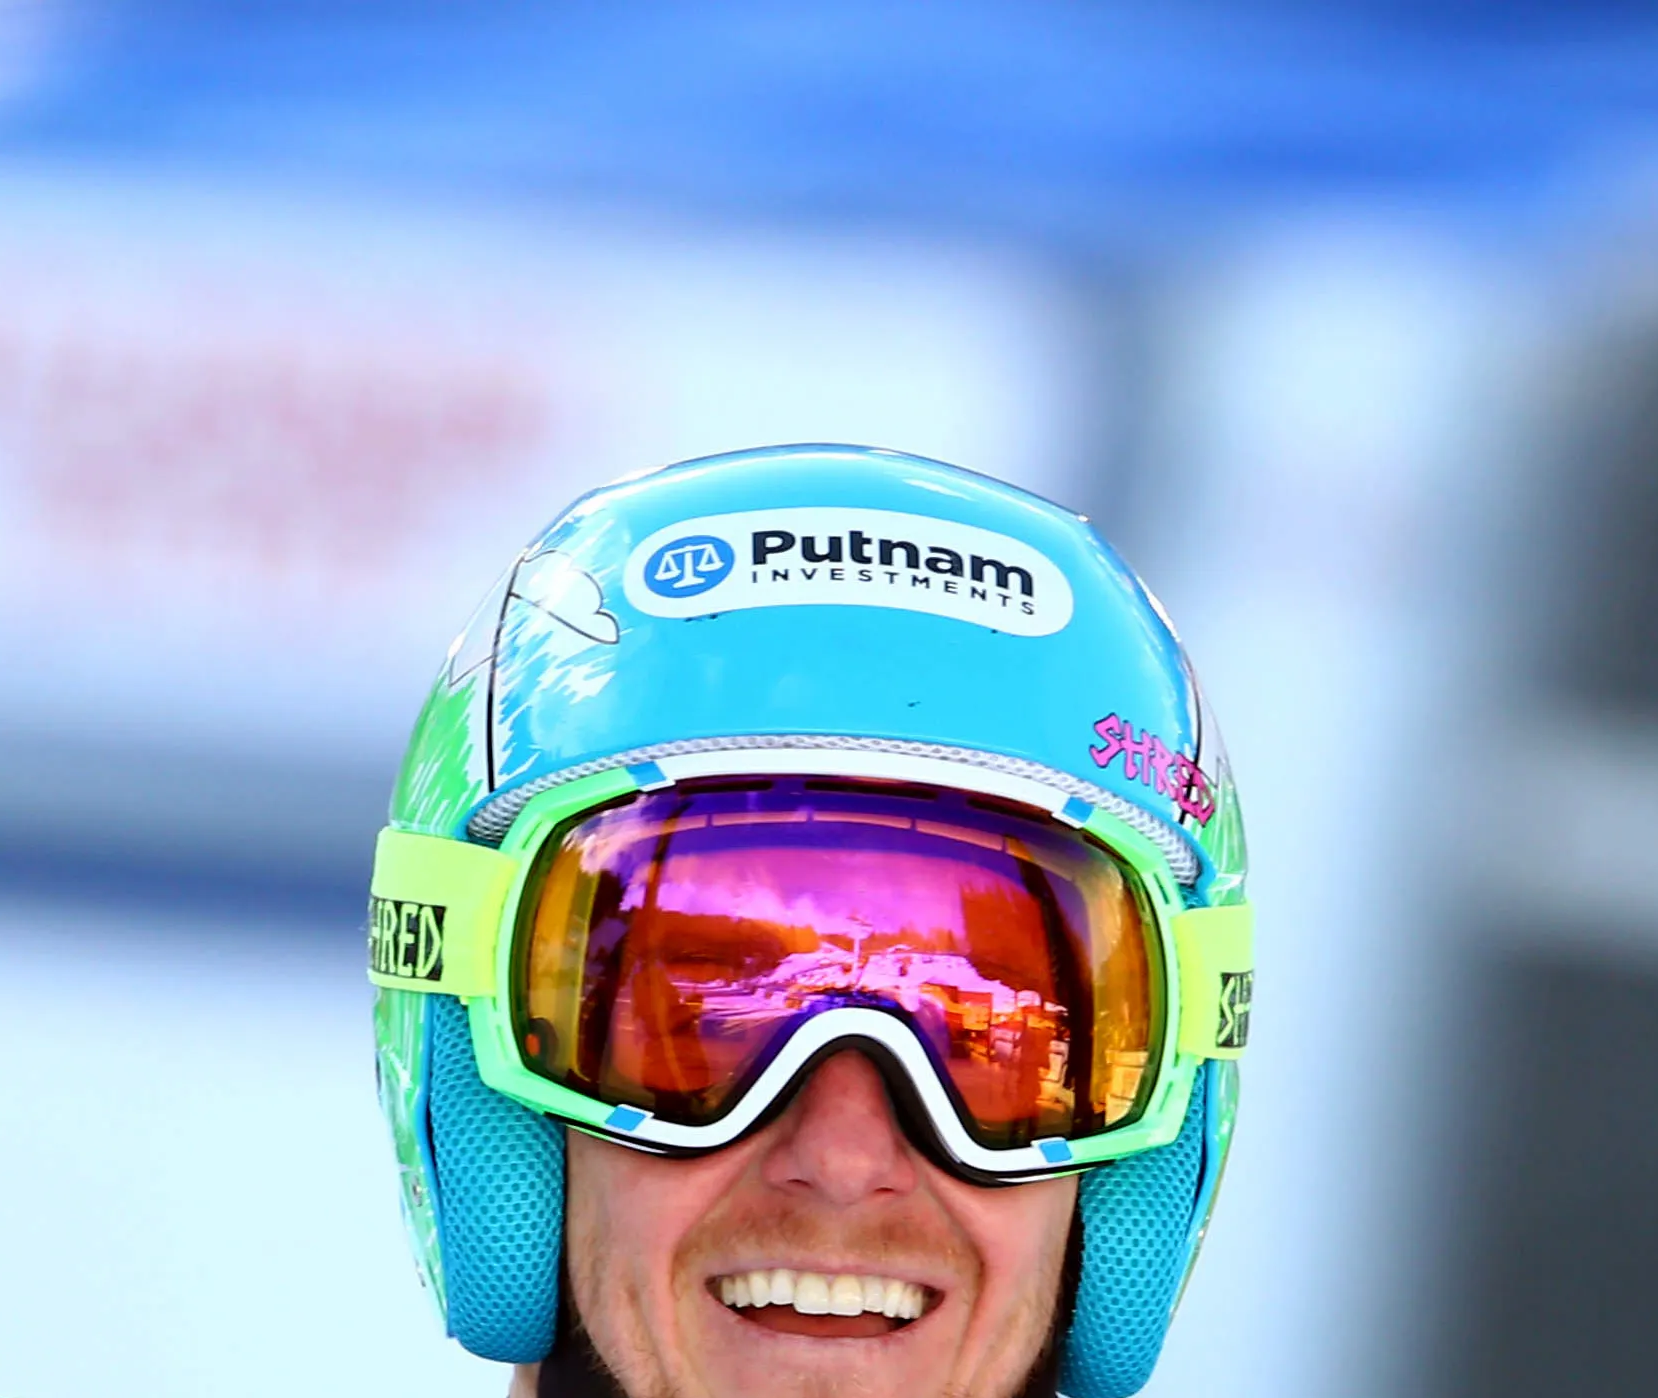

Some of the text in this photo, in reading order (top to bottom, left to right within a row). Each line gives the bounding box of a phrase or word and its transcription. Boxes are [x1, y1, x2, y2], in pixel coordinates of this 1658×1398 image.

[751, 529, 1035, 598] Putnam
[751, 566, 1036, 616] INVESTMENTS
[1089, 712, 1216, 828] SHRED
[367, 898, 444, 978] HRED
